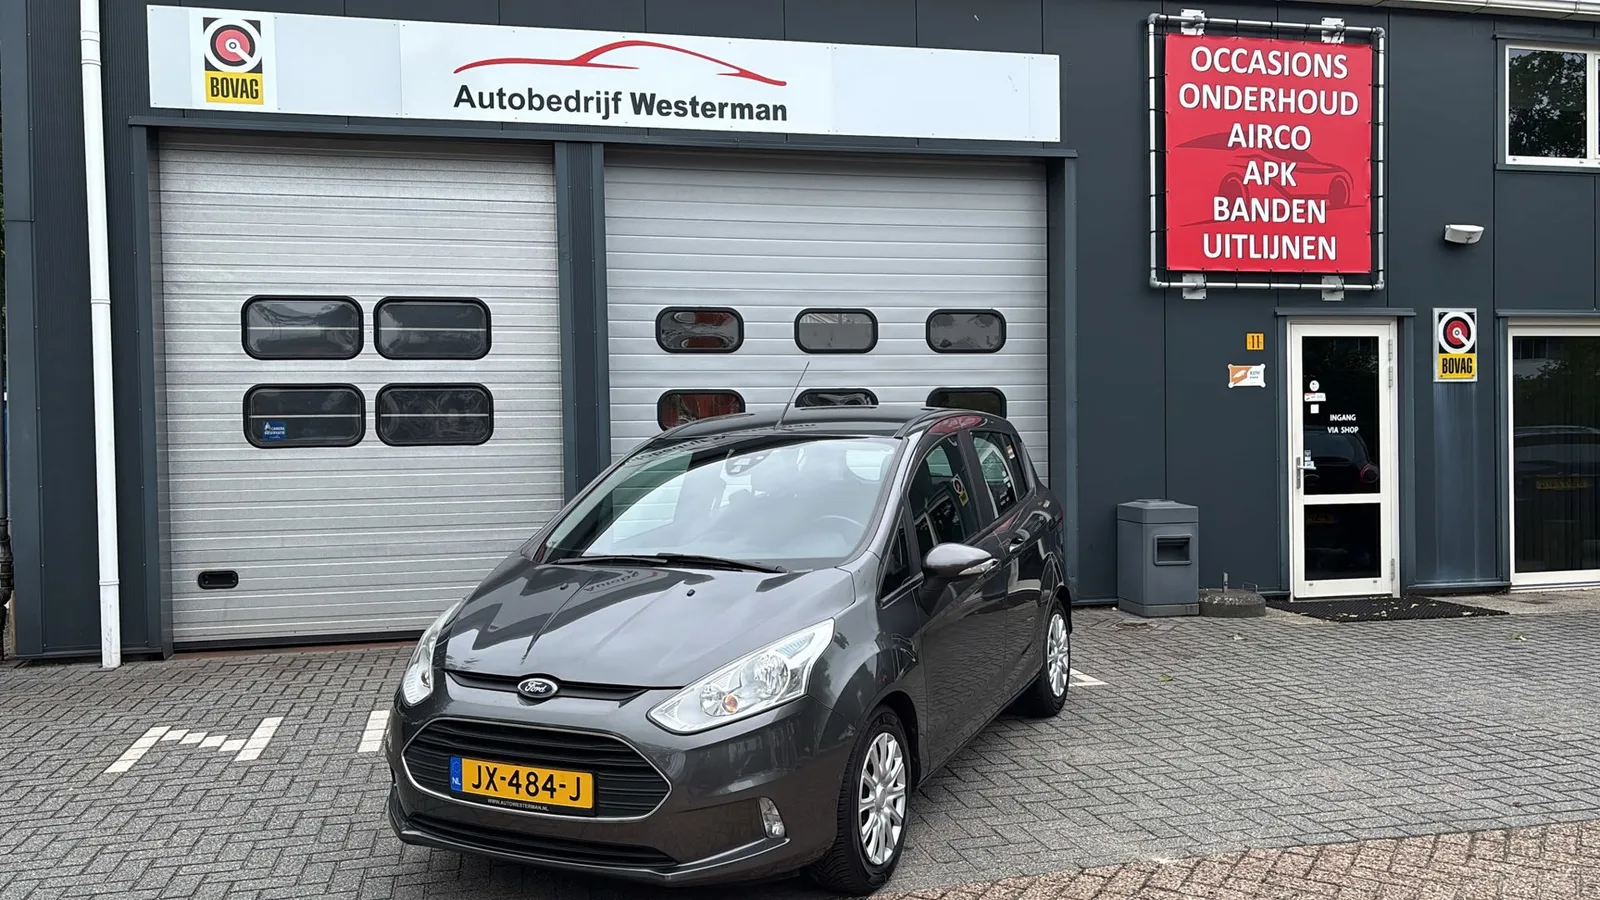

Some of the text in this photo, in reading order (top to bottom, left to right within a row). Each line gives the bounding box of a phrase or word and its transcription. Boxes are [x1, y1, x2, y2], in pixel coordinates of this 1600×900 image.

[1191, 46, 1348, 79] OCCASIONS
[210, 76, 259, 99] BOVAG
[1178, 83, 1359, 116] ONDERHOUD
[453, 84, 787, 121] Autobedrijf Westerman
[1227, 123, 1311, 150] AIRCO
[1242, 160, 1298, 187] APK
[1213, 196, 1327, 224] BANDEN
[1203, 233, 1337, 261] UITLIJNEN
[1251, 335, 1260, 349] 11
[1442, 357, 1472, 374] BOVAG
[1327, 426, 1339, 434] VIA
[524, 681, 547, 692] Ford
[452, 764, 581, 802] NL JX-484-J
[487, 798, 549, 811] WWW.AUTOWESTERMAN.NL
